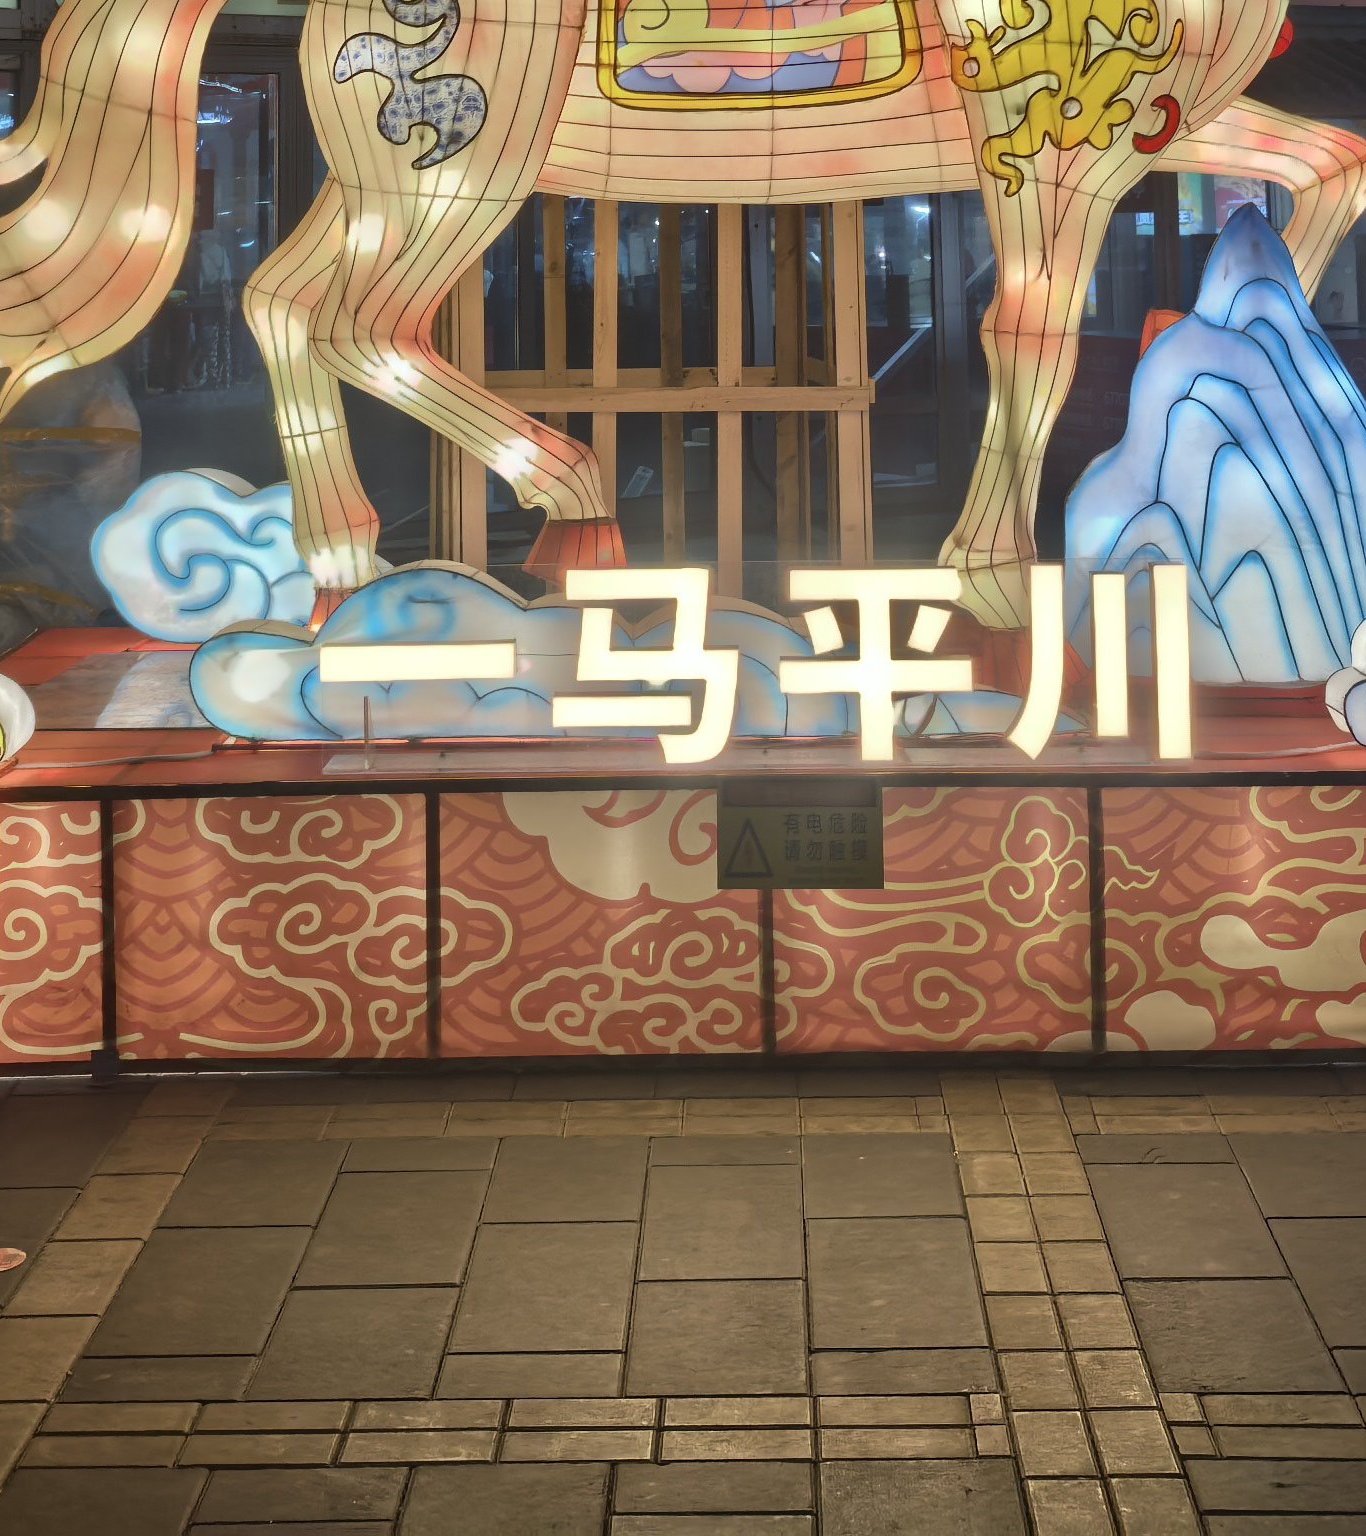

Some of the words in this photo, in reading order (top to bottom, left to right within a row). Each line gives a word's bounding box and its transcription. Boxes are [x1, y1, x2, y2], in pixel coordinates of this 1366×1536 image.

[319, 563, 1193, 764] 一马平川
[782, 812, 869, 835] 有电危险
